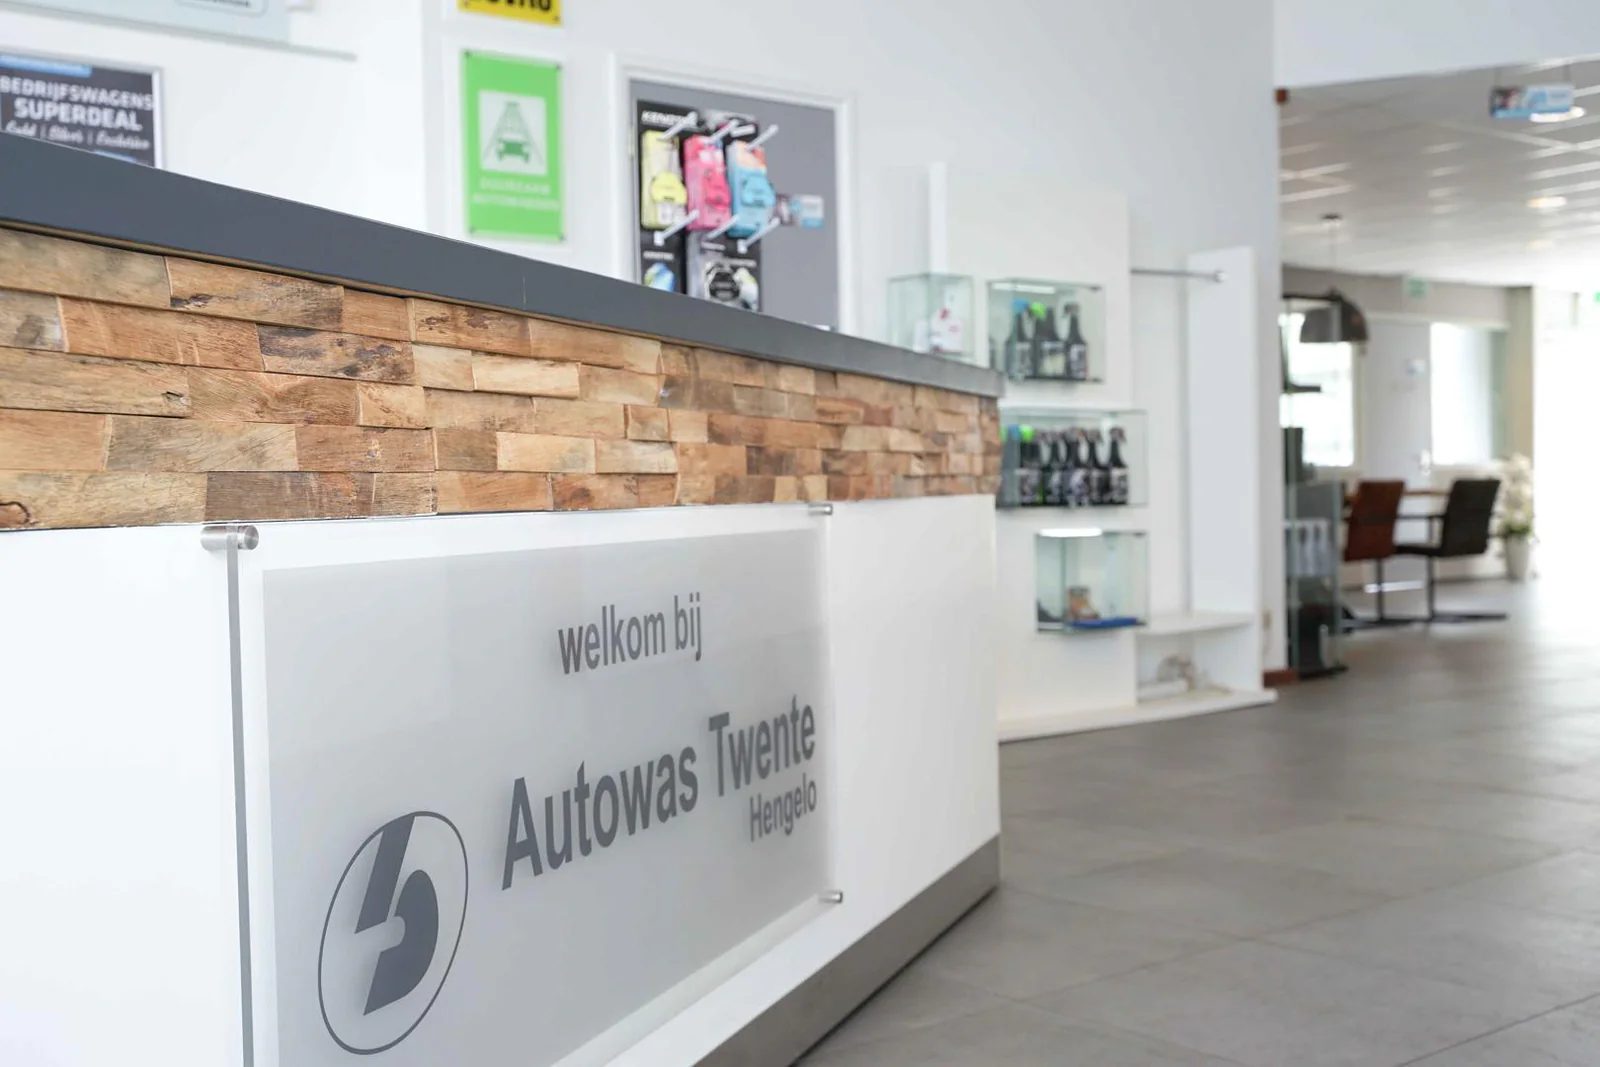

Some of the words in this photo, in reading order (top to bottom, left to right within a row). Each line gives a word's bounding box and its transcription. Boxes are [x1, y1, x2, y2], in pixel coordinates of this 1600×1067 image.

[0, 75, 154, 111] BEDRIJFSWAGENS
[14, 97, 143, 131] SUPERDEAL
[558, 604, 666, 675] welkom
[674, 592, 702, 662] bij
[501, 745, 699, 891] Autowas
[708, 694, 816, 798] Twente
[748, 771, 817, 843] Hengelo
